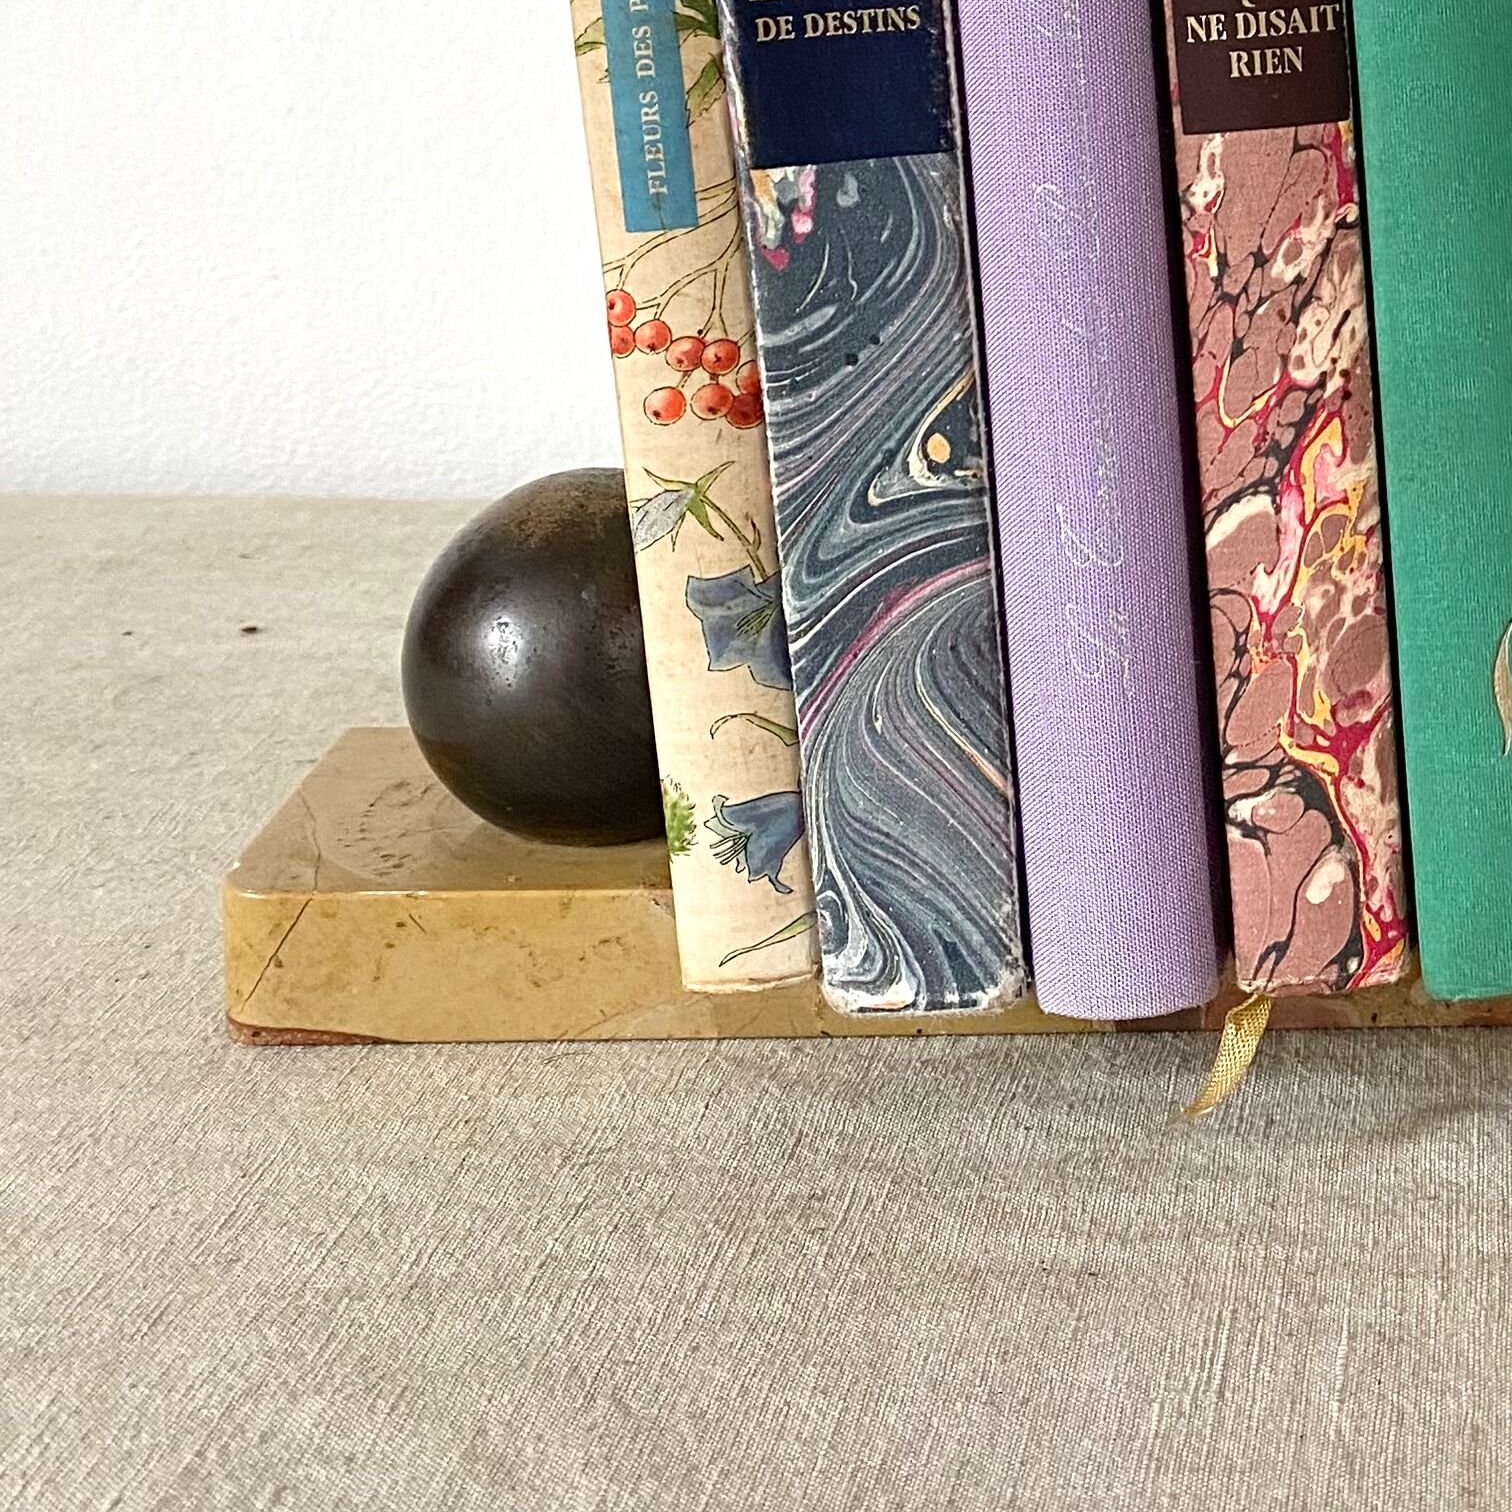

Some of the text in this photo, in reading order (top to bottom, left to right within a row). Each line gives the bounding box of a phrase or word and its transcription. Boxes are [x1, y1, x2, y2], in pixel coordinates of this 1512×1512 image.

[755, 4, 921, 42] DE DESTINS
[1186, 3, 1341, 44] NE DISAIT
[634, 24, 656, 79] DES
[1230, 46, 1304, 78] RIEN
[640, 91, 668, 196] FLEURS
